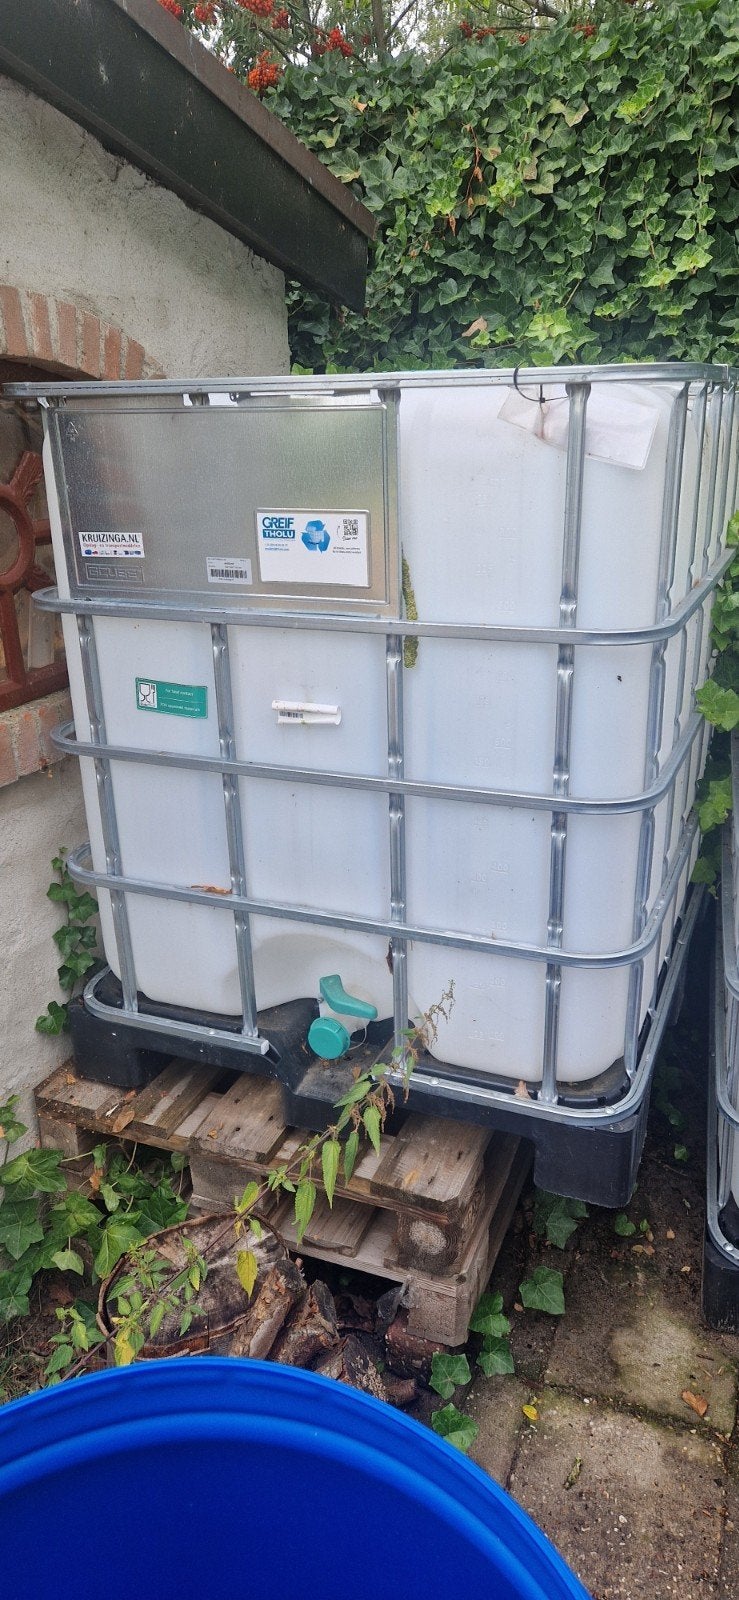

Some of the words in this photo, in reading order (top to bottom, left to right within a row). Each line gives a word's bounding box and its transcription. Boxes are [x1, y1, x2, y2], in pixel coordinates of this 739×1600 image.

[262, 517, 294, 529] GREIF
[82, 534, 140, 543] KRUIZINGA.NL
[263, 530, 295, 538] THOLU
